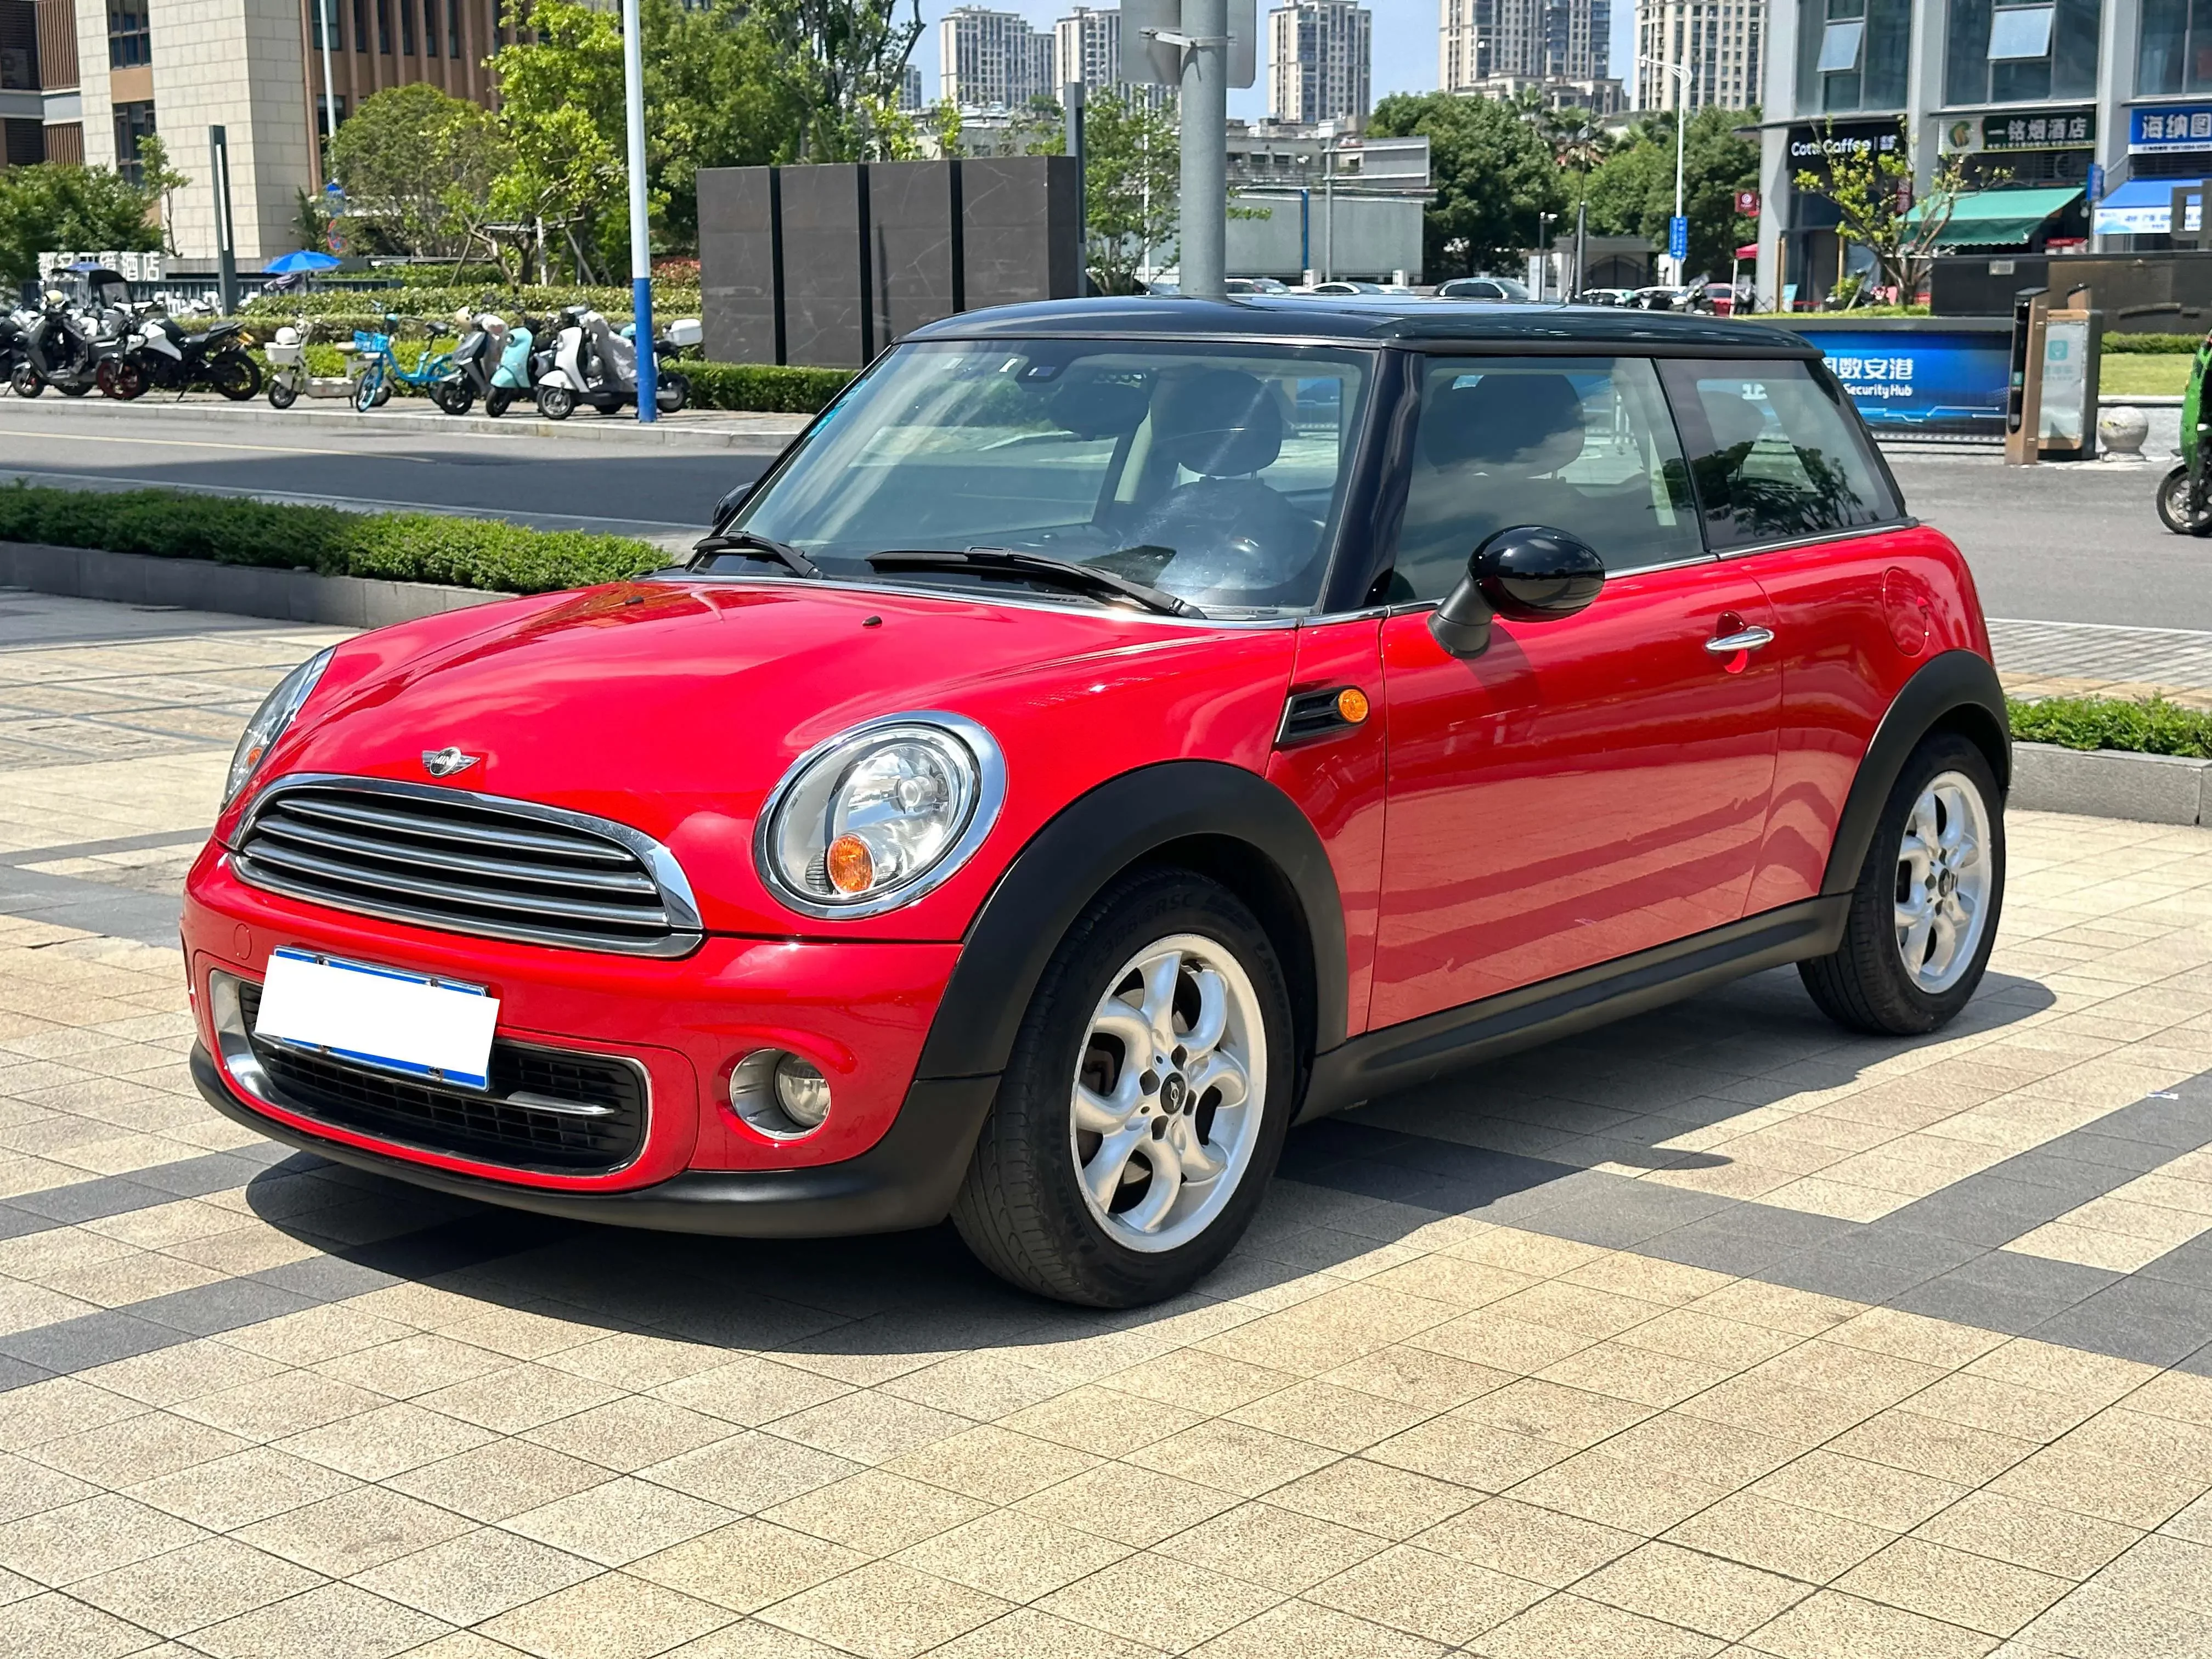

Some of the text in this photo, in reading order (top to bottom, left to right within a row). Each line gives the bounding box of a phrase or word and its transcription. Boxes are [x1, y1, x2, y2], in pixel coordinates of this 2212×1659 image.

[1822, 138, 1872, 154] Coffee
[1843, 383, 1913, 399] Security Hub
